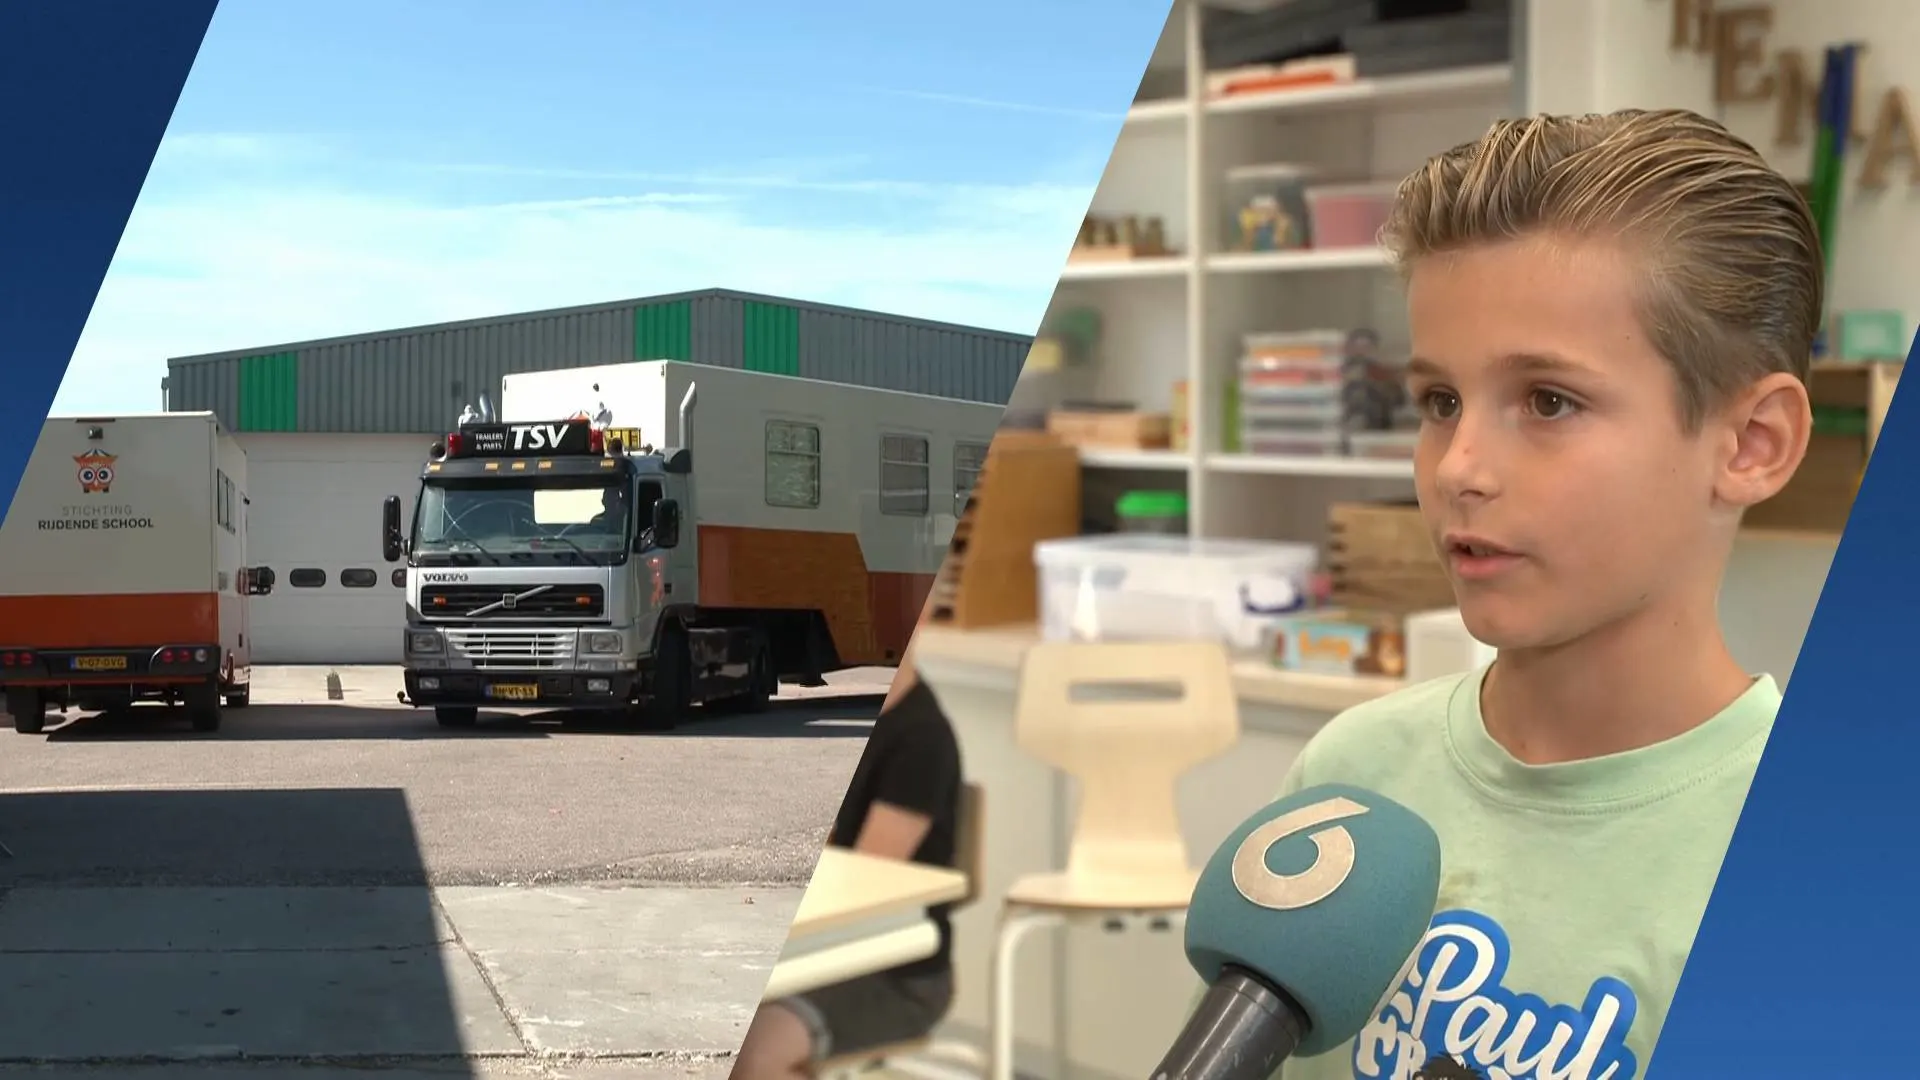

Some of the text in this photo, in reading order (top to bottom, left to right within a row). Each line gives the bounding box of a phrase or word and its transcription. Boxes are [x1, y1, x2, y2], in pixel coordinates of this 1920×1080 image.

[475, 433, 503, 441] TRAILERS
[511, 424, 570, 450] TSV
[61, 504, 132, 516] STICHTING
[38, 518, 154, 530] RIJDENDE SCHOOL
[422, 573, 469, 582] VOLVO
[1231, 797, 1370, 910] 6
[1408, 923, 1620, 1080] Paul
